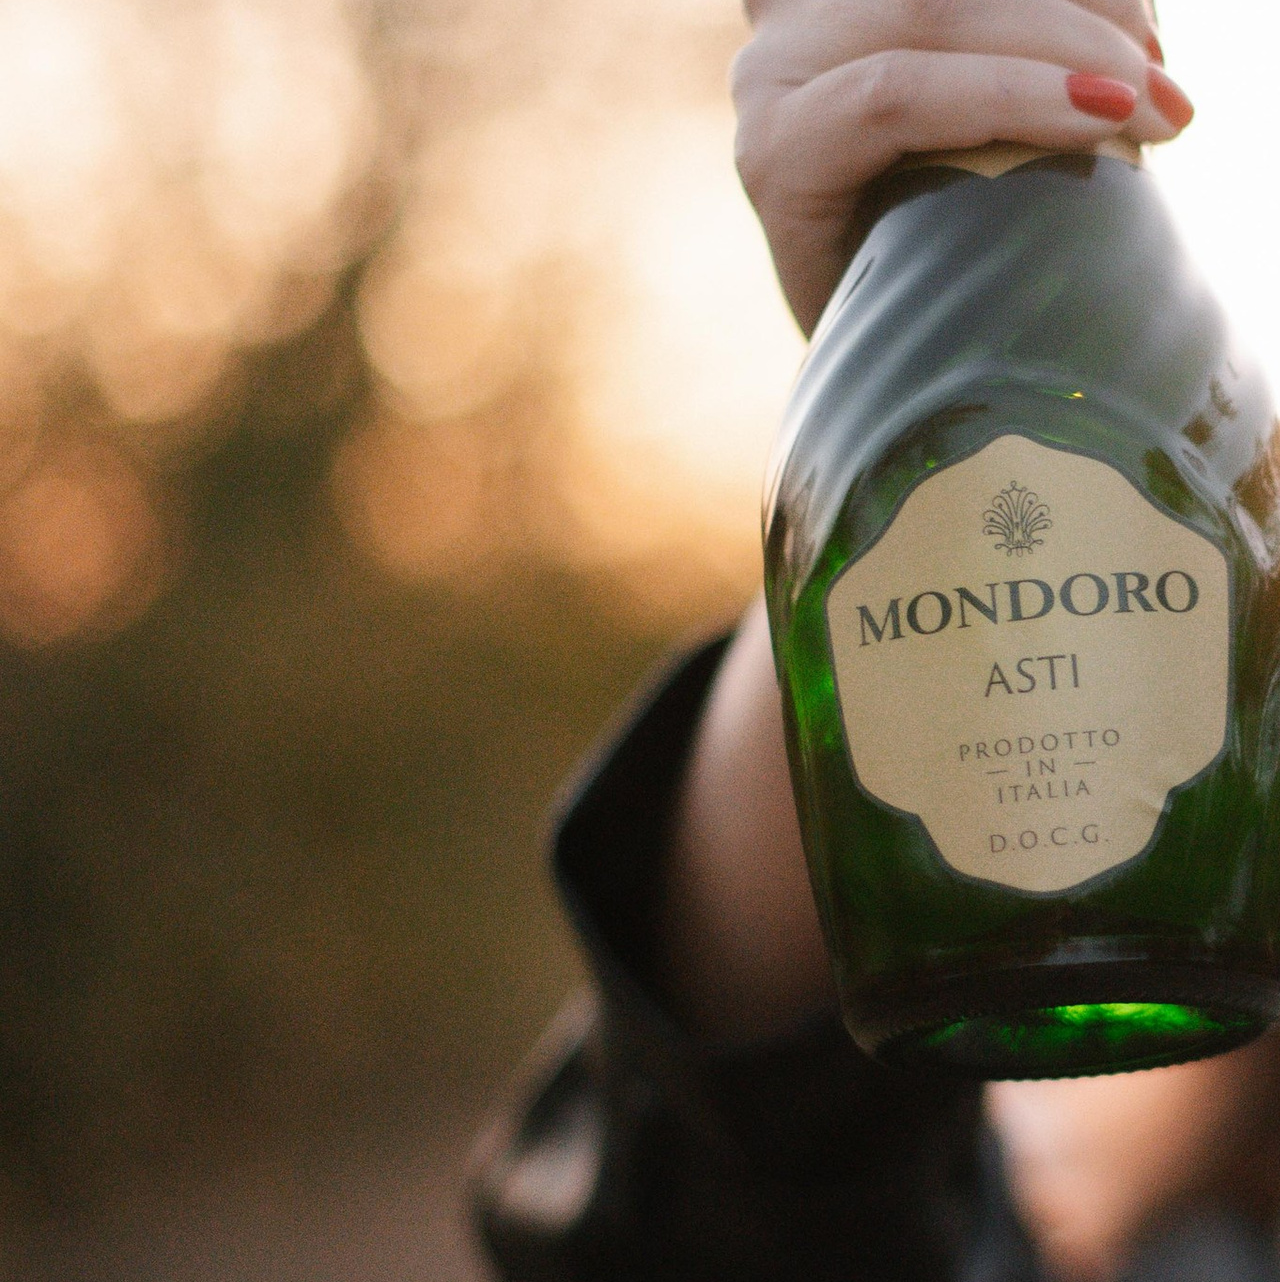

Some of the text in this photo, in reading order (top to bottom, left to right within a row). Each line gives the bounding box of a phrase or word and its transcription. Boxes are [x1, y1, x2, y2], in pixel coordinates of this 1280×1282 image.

[856, 569, 1200, 647] MONDORO
[984, 653, 1080, 698] ASTI
[959, 728, 1122, 762] PRODOTTO
[1026, 759, 1056, 777] IN
[997, 779, 1090, 805] ITALIA
[990, 823, 1110, 854] D.O.C.G.
